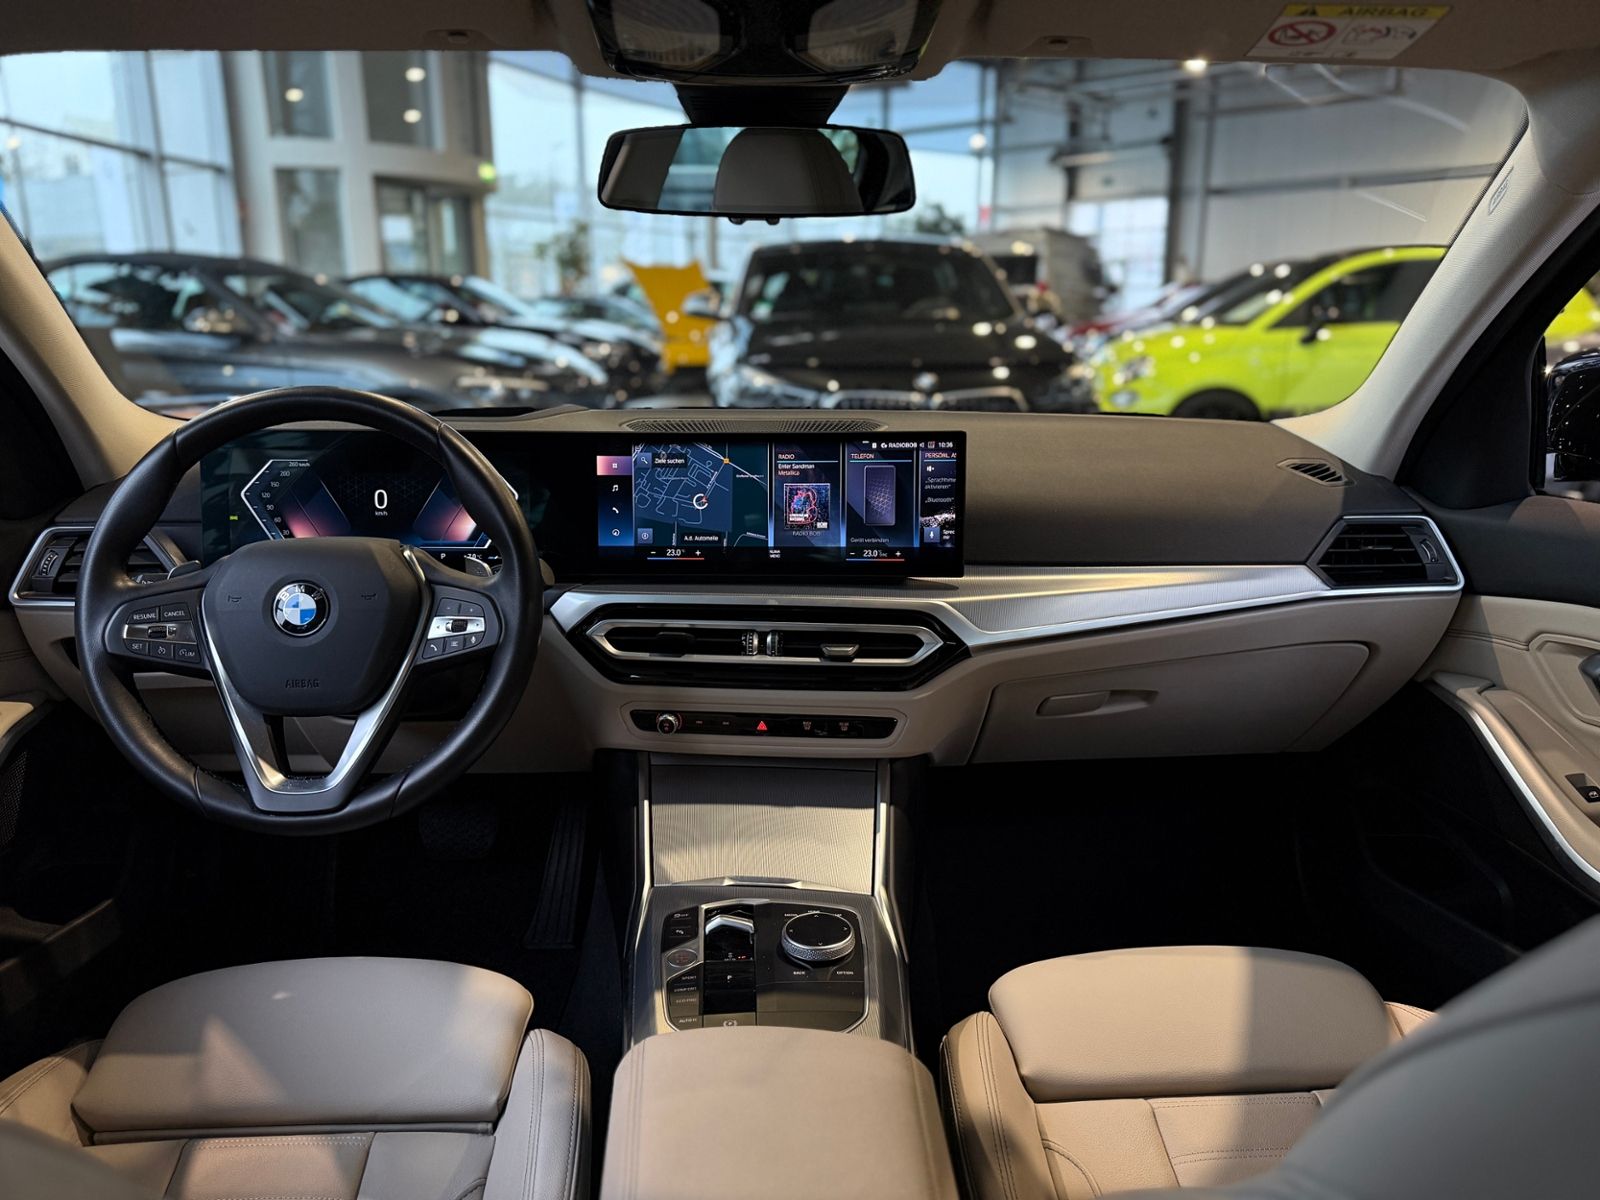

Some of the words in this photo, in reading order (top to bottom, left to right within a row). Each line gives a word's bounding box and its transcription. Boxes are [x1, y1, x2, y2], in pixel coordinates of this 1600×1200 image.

[1338, 6, 1429, 16] AIRBAG
[374, 489, 388, 509] 0
[284, 679, 320, 689] AIRBAG
